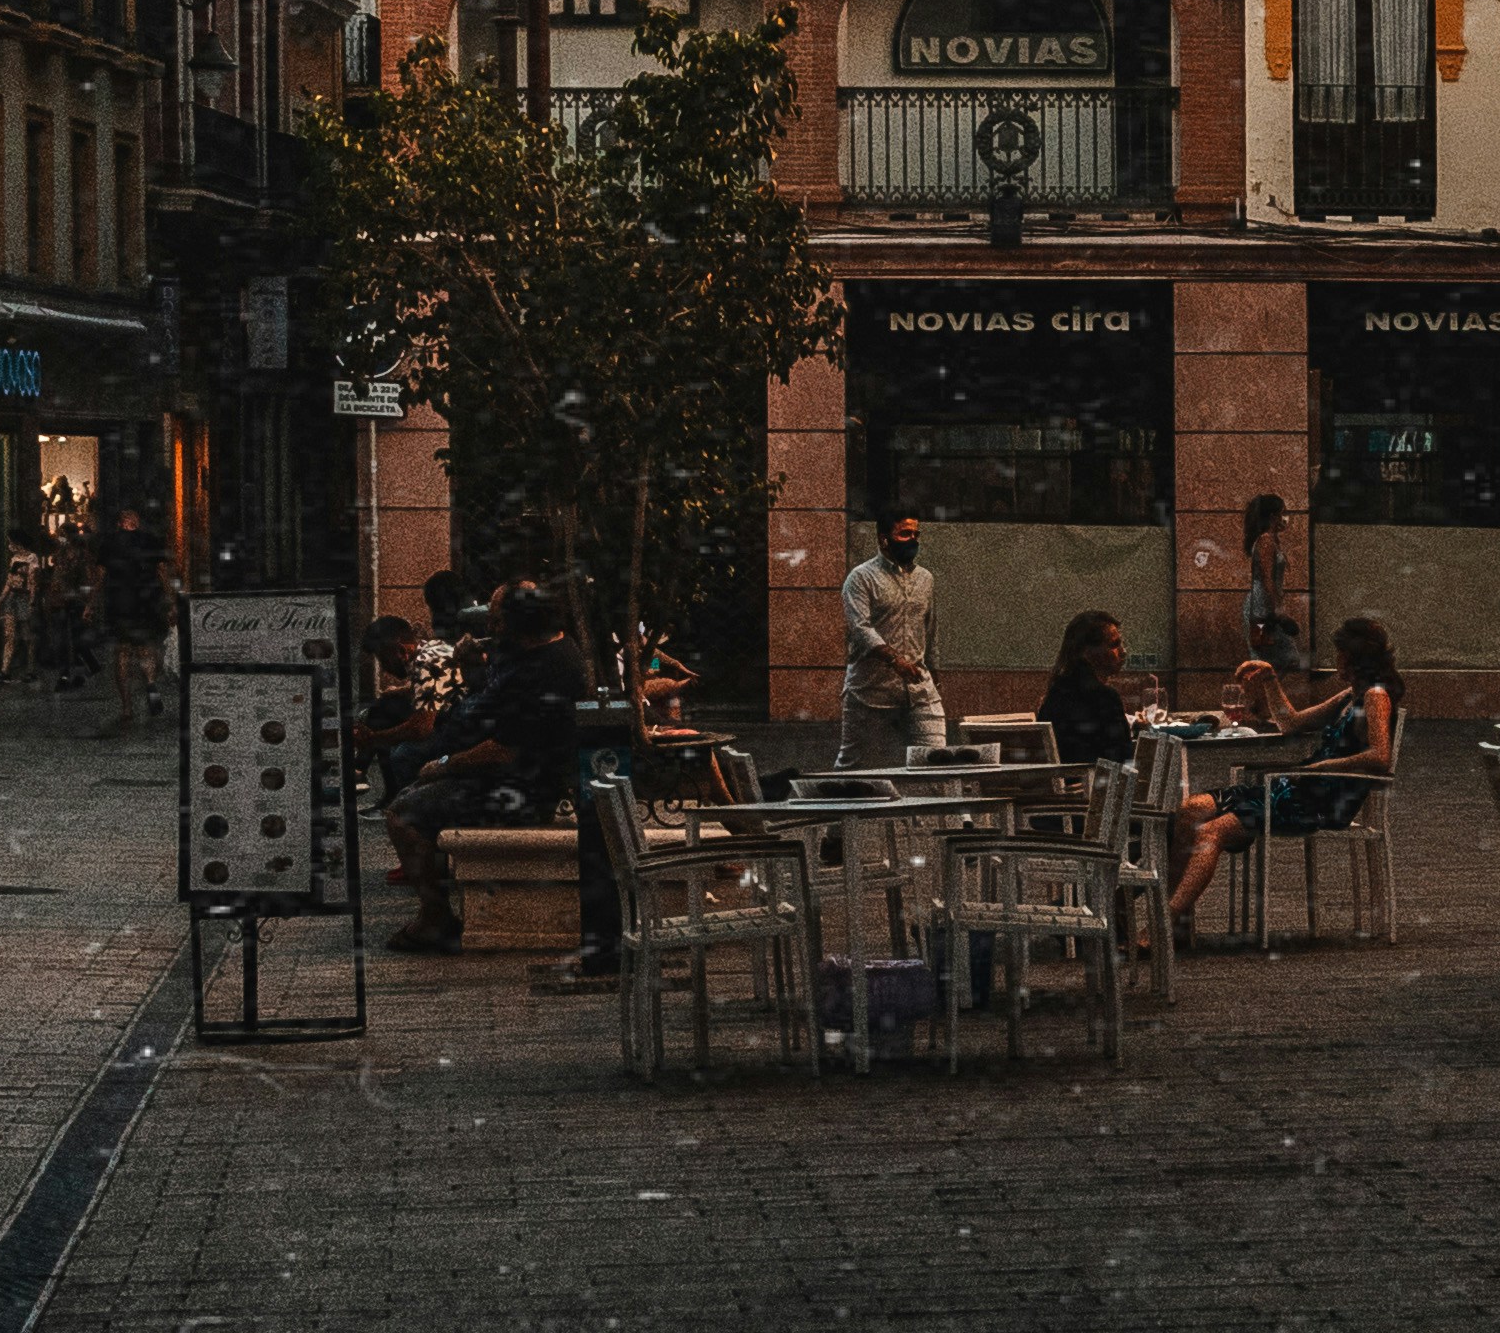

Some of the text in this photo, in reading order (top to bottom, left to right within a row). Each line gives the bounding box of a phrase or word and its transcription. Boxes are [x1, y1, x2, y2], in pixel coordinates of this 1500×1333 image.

[910, 37, 1098, 64] NOVIAS
[889, 305, 1131, 333] NOVIAS cira
[195, 602, 261, 633] Casa
